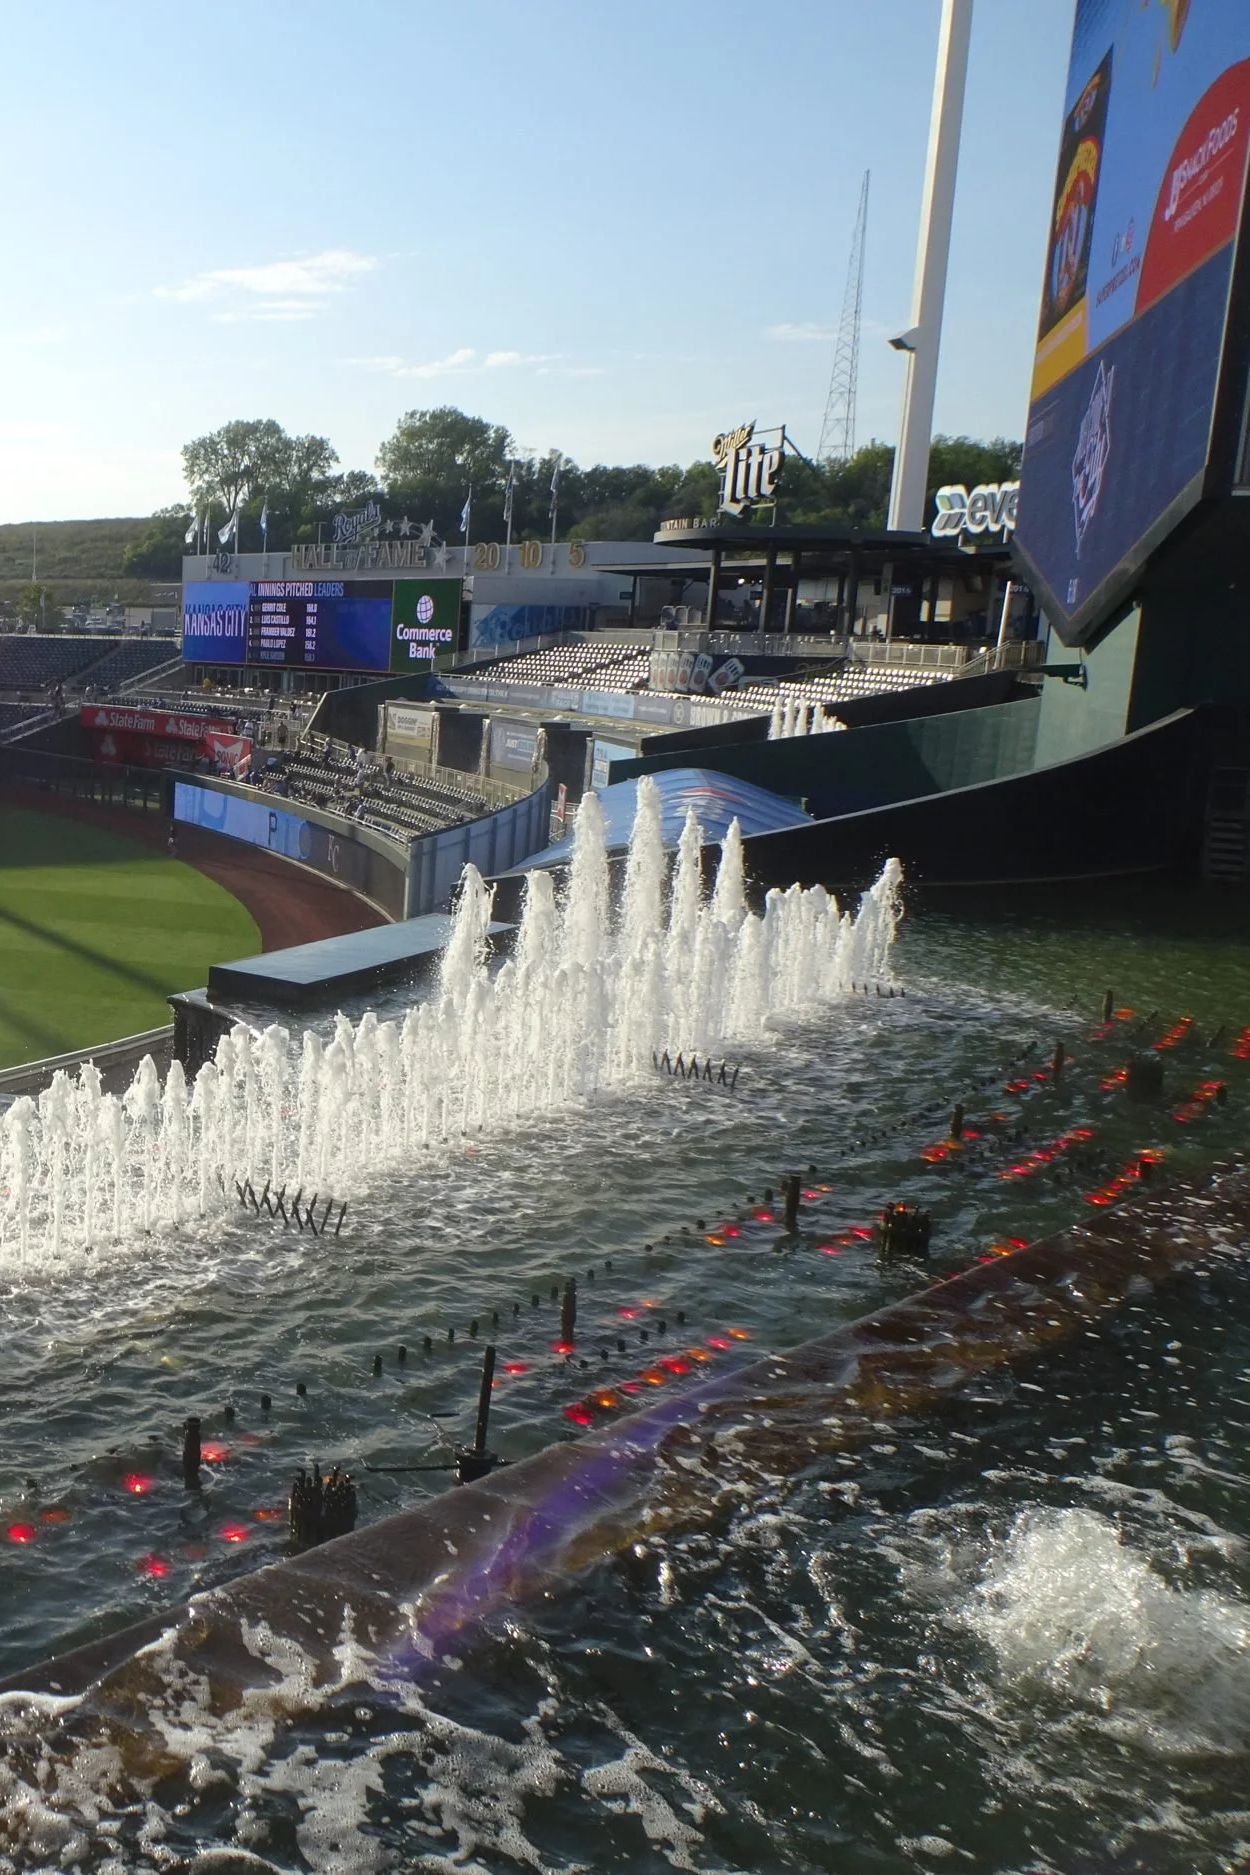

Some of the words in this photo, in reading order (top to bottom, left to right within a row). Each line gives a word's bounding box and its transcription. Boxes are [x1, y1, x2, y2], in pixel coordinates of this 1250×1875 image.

[712, 419, 757, 462] Miller
[715, 443, 785, 517] Lite
[332, 500, 382, 543] Royals
[692, 517, 717, 529] BAR
[212, 552, 231, 574] 42
[291, 543, 343, 569] HALL
[364, 540, 427, 568] FAME
[474, 542, 499, 570] 20
[519, 540, 543, 569] 10
[567, 540, 585, 568] 5
[258, 582, 285, 597] INNINGS
[285, 582, 313, 597] PITCHED
[314, 582, 345, 597] LEADERS
[184, 610, 223, 637] KANSAS
[224, 609, 247, 637] CITY
[396, 624, 453, 642] Commerce
[409, 643, 436, 659] Bank
[217, 749, 240, 765] SONIC
